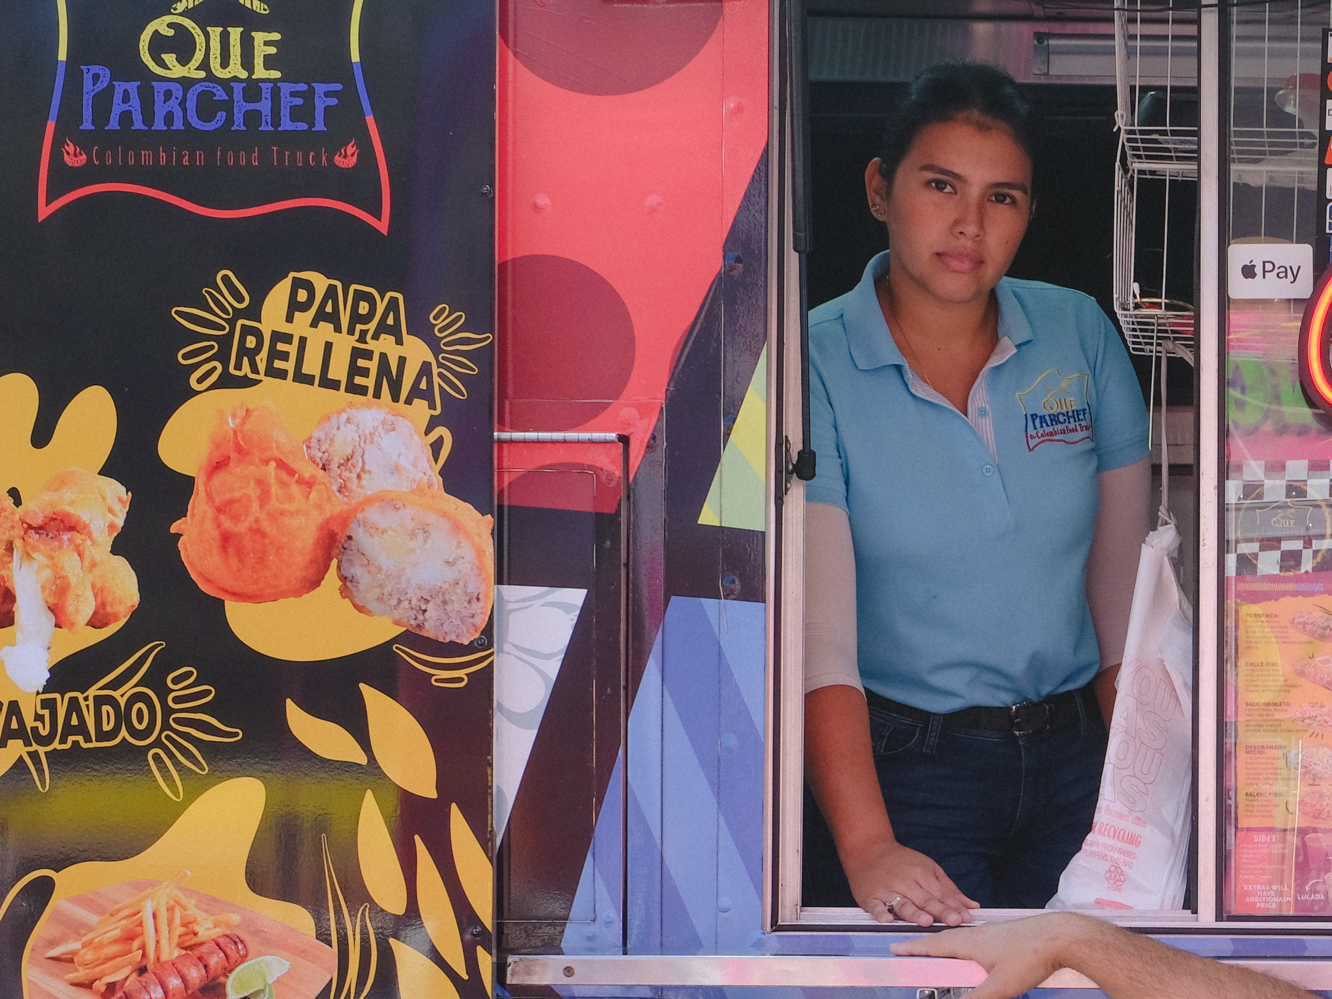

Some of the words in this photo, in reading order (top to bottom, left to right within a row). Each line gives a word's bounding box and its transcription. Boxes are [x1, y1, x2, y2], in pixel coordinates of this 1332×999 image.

[78, 65, 343, 131] PARCHEF
[92, 146, 205, 166] Colombian
[270, 147, 329, 167] Truck
[1262, 260, 1301, 284] Pay
[285, 274, 406, 345] PAPA
[232, 321, 440, 412] RELLENA
[1030, 408, 1087, 430] PARCHEF
[0, 691, 158, 750] AJADO
[1097, 821, 1143, 848] RECYCLING
